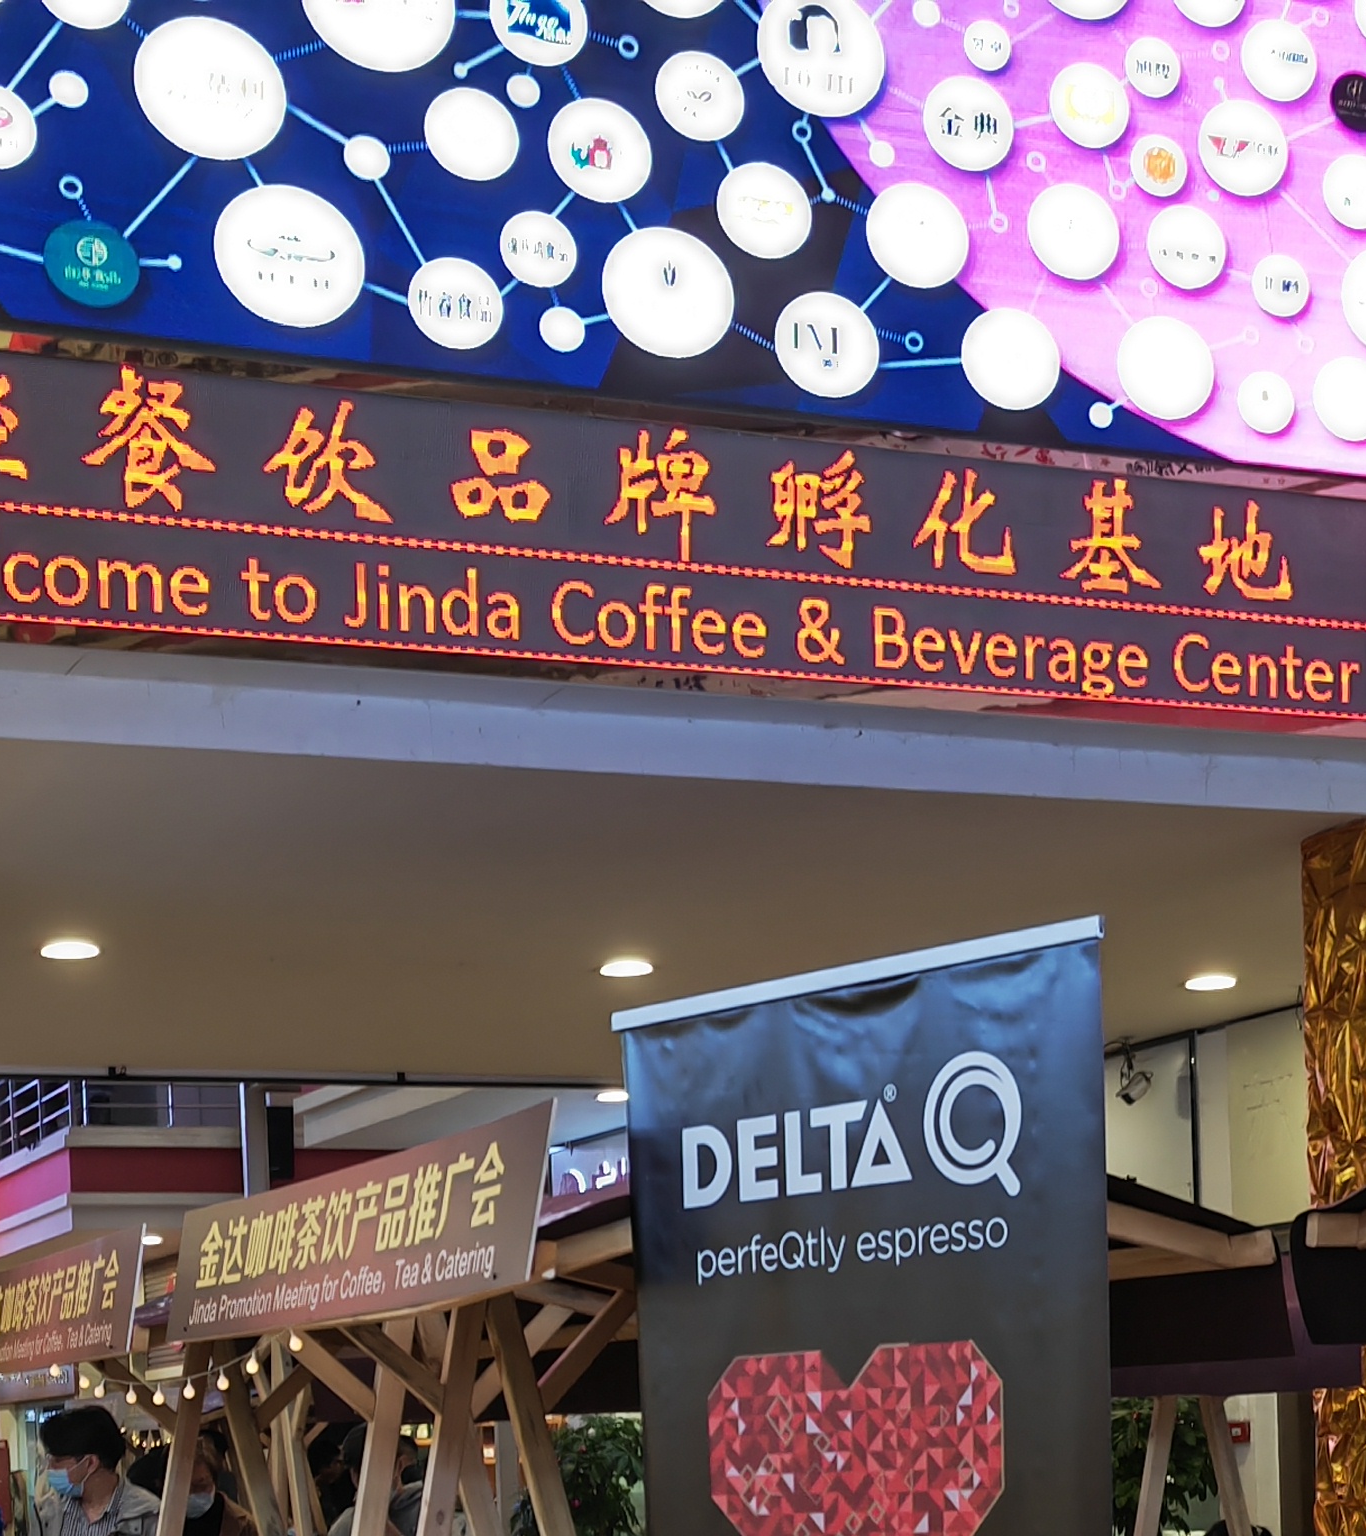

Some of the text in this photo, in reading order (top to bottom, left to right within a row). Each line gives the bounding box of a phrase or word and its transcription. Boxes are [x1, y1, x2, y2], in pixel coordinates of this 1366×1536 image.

[240, 556, 318, 624] to
[343, 560, 520, 641] Jinda
[550, 580, 767, 659] Coffee
[796, 597, 846, 665] &
[872, 606, 1150, 698] Beverage
[1173, 633, 1361, 704] Center
[923, 1050, 1022, 1197] Q
[195, 1141, 505, 1290] 金达咖啡茶饮产品推广会
[696, 1216, 1009, 1285] perfeQtly espresso
[84, 1320, 113, 1347] Catering
[188, 1298, 217, 1326] Jinda
[219, 1290, 272, 1320] Promotion
[273, 1279, 320, 1311] Meeting
[320, 1276, 339, 1302] for
[395, 1257, 420, 1288] Tea
[421, 1252, 432, 1278] &
[434, 1241, 496, 1281] Catering
